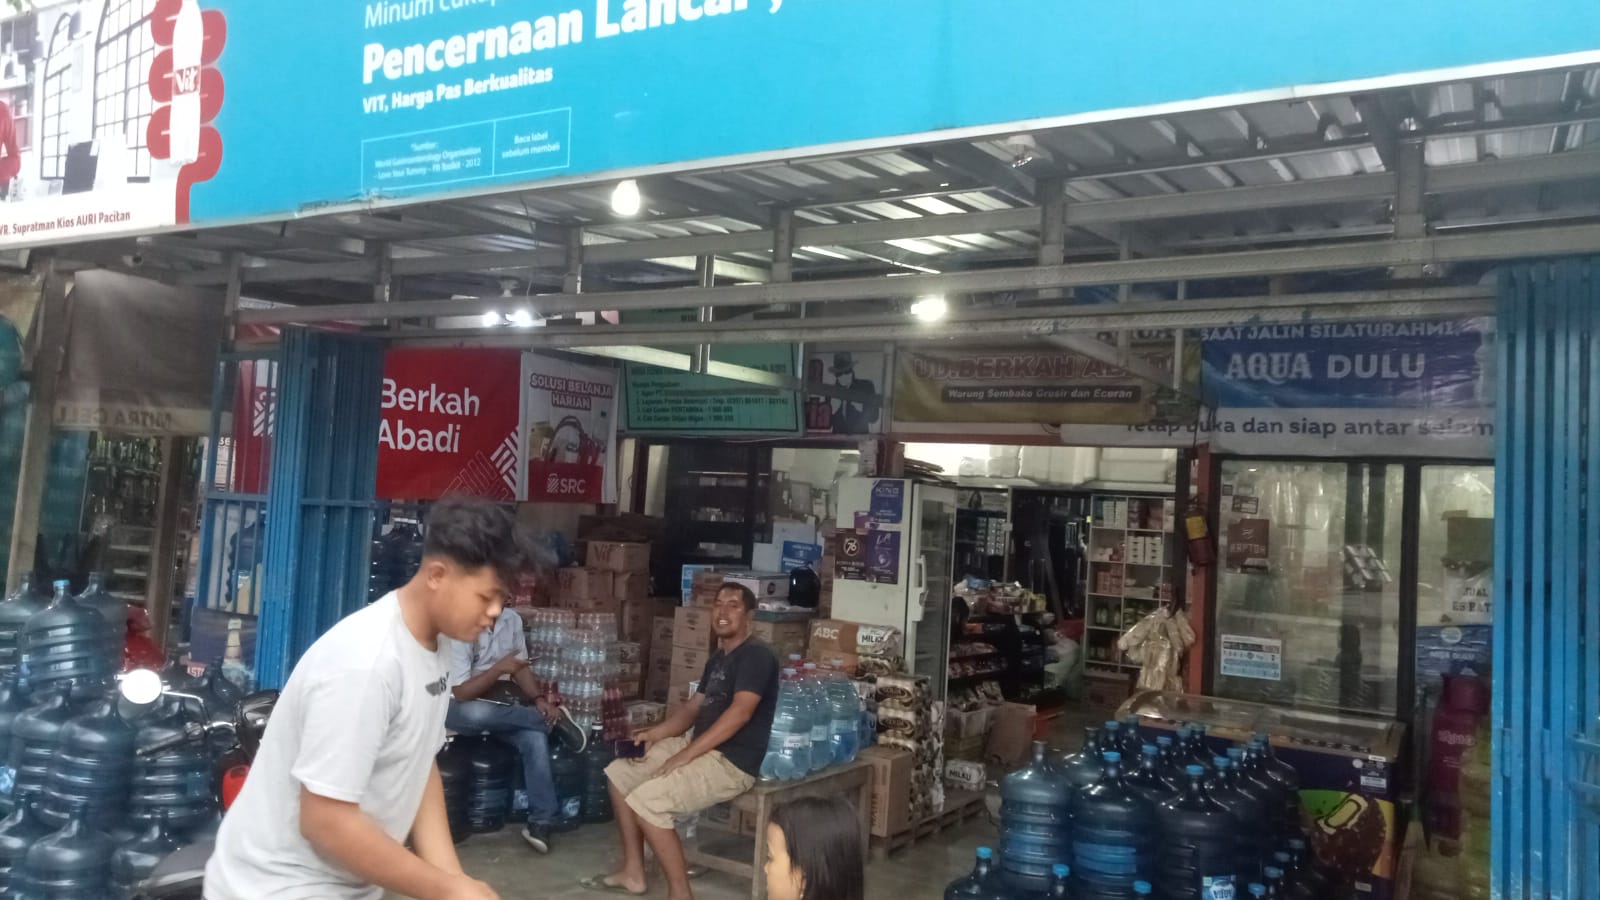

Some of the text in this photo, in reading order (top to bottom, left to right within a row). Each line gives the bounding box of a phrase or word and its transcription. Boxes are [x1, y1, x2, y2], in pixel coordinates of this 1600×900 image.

[365, 1, 434, 29] Minum
[363, 9, 583, 84] Pencernaan
[363, 66, 554, 114] VIT, Harga Pas Berkualitas
[12, 220, 56, 237] Supratman
[56, 218, 75, 230] Kios
[76, 213, 97, 228] AURI
[98, 210, 131, 225] Pacitan
[1201, 327, 1243, 341] SAAT
[1247, 325, 1305, 340] JALIN
[1223, 351, 1426, 384] AQUA DULU
[379, 378, 481, 417] Berkah
[531, 374, 613, 397] SOLUSI BELANJA
[948, 388, 985, 400] Warung
[988, 387, 1033, 399] Sembako
[1071, 387, 1091, 399] dan
[1094, 386, 1134, 399] Eceran
[552, 392, 591, 408] HARIAN
[377, 419, 461, 454] Abadi
[1242, 418, 1283, 434] dan
[1289, 418, 1337, 439] siap
[1344, 419, 1411, 436] antar
[559, 478, 586, 494] SRC
[813, 627, 840, 640] ABC
